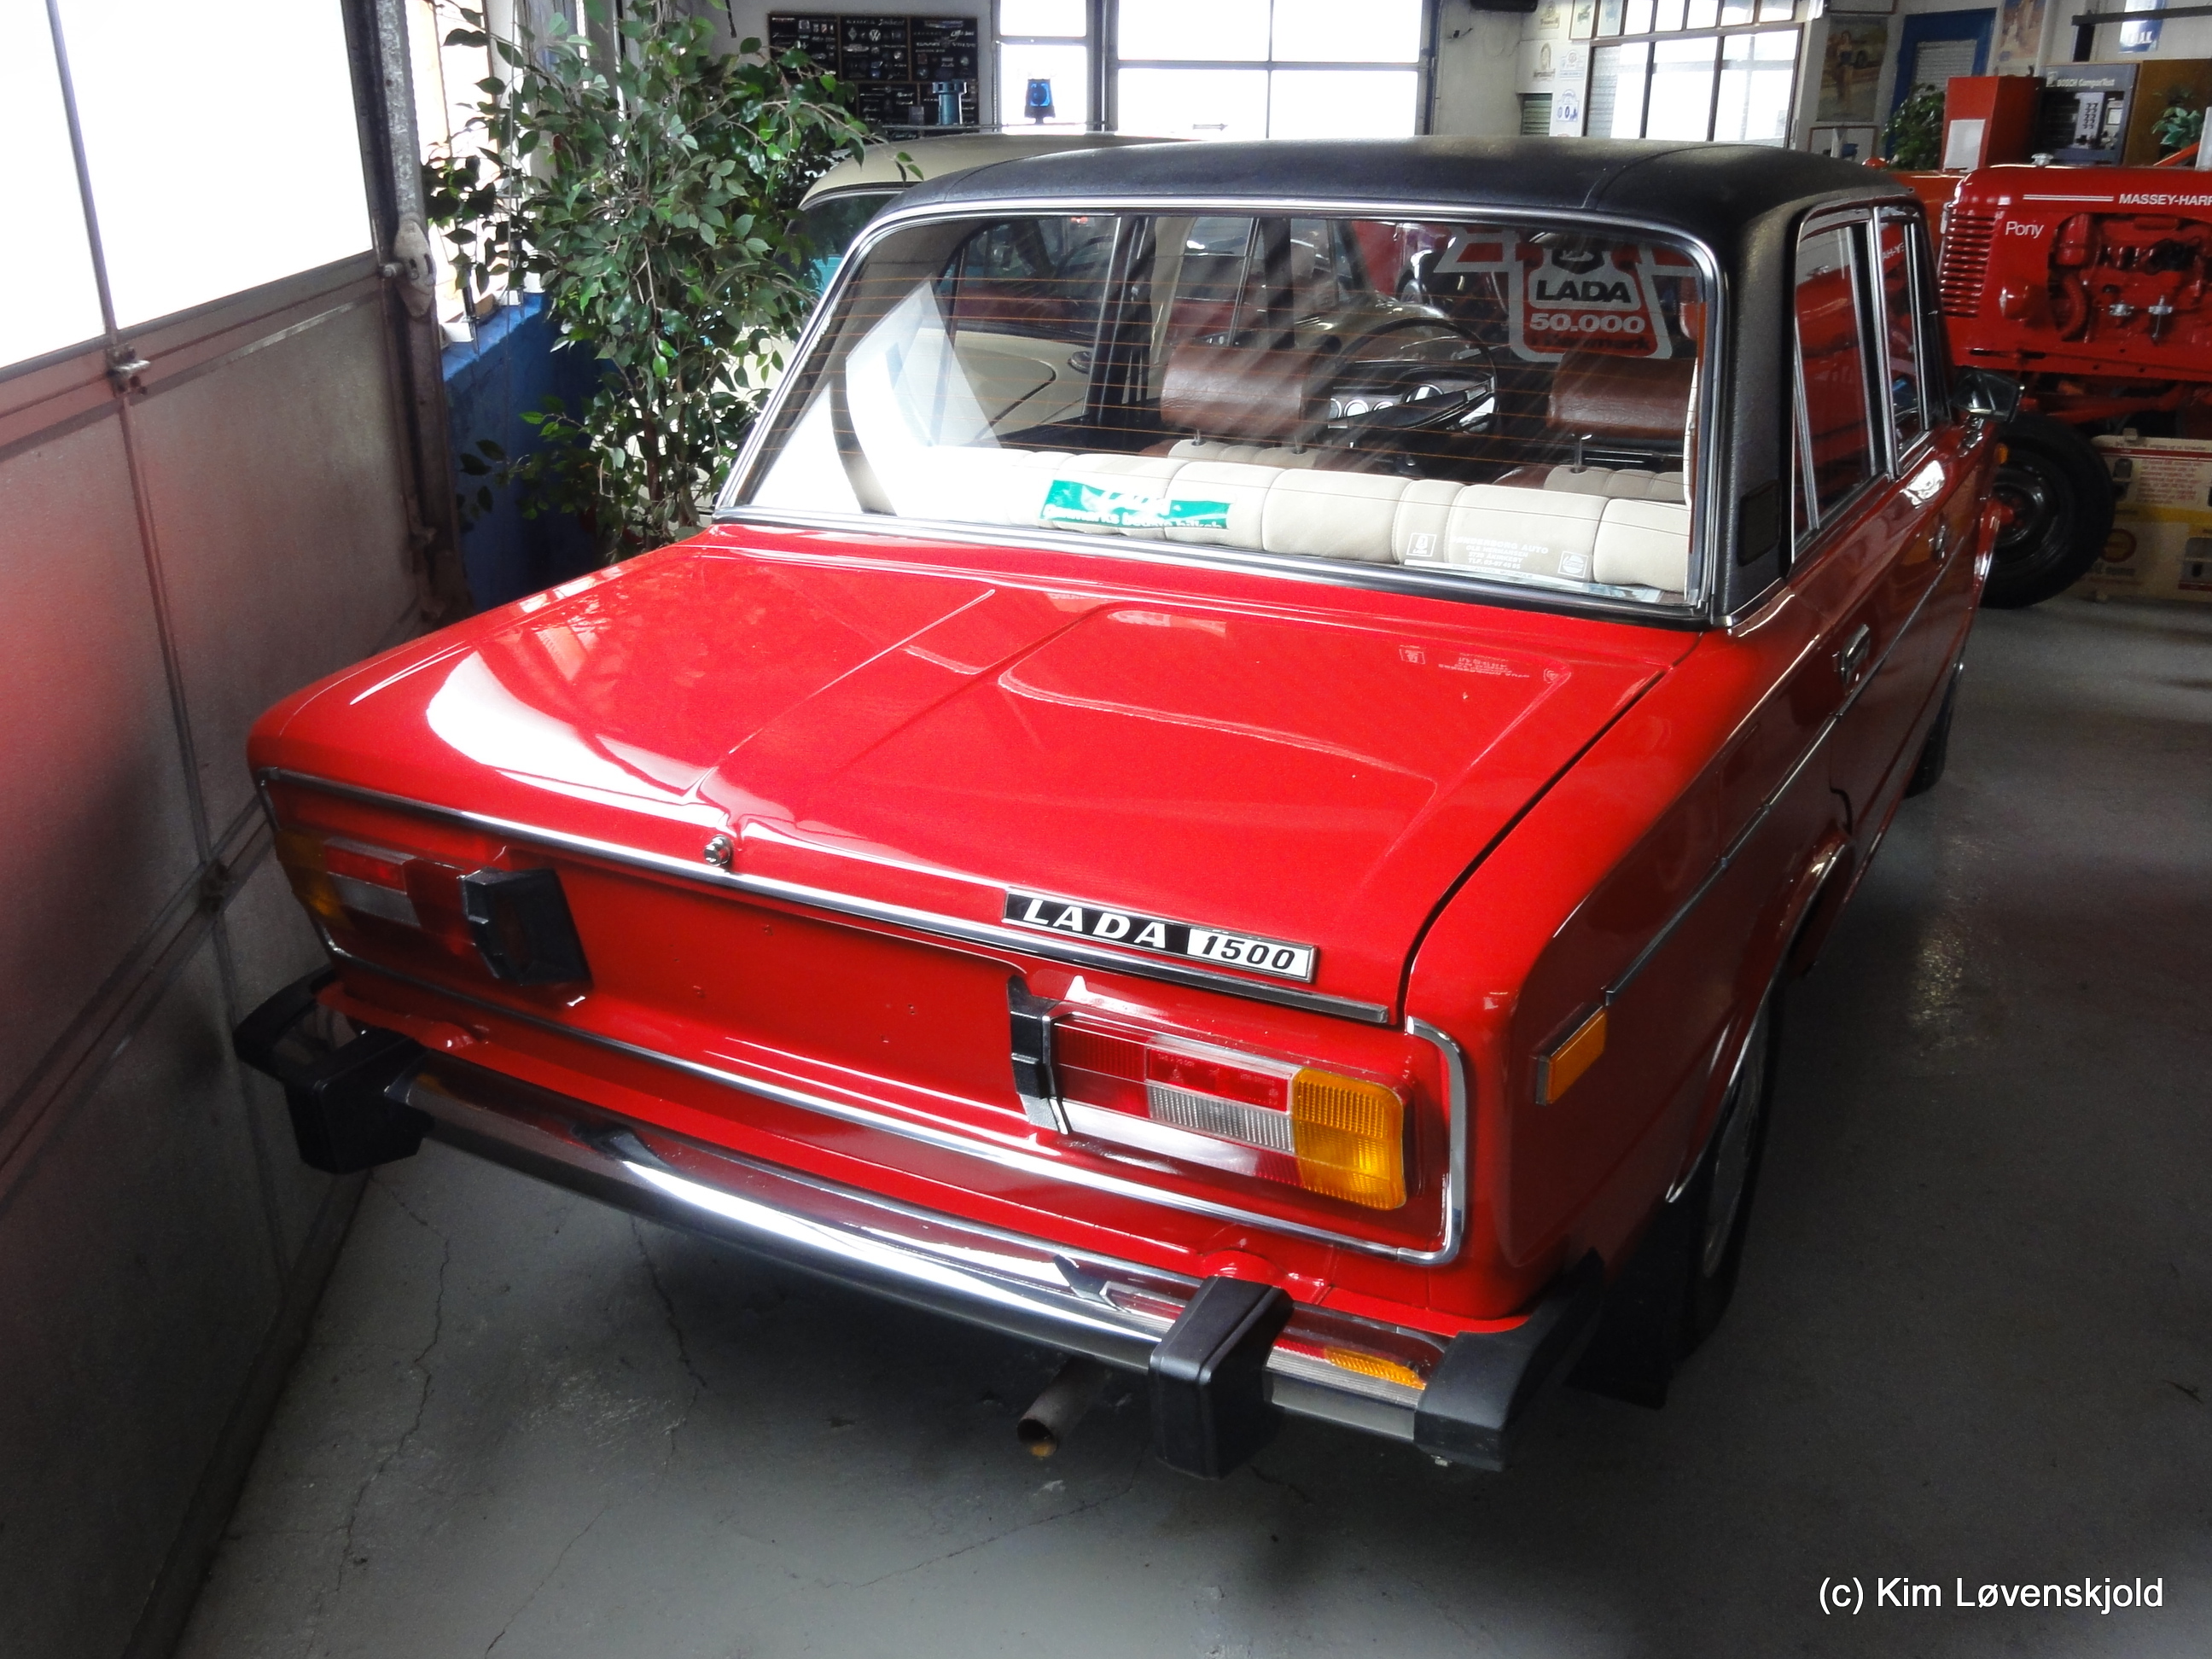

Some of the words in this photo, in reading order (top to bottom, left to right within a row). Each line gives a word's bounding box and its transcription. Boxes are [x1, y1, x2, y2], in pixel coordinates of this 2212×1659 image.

[2005, 221, 2044, 238] Pony
[1536, 280, 1632, 304] LADA
[1529, 313, 1645, 334] 50.000
[1522, 544, 1549, 555] AUTO
[1022, 899, 1167, 949] LADA
[1201, 935, 1295, 970] 1500
